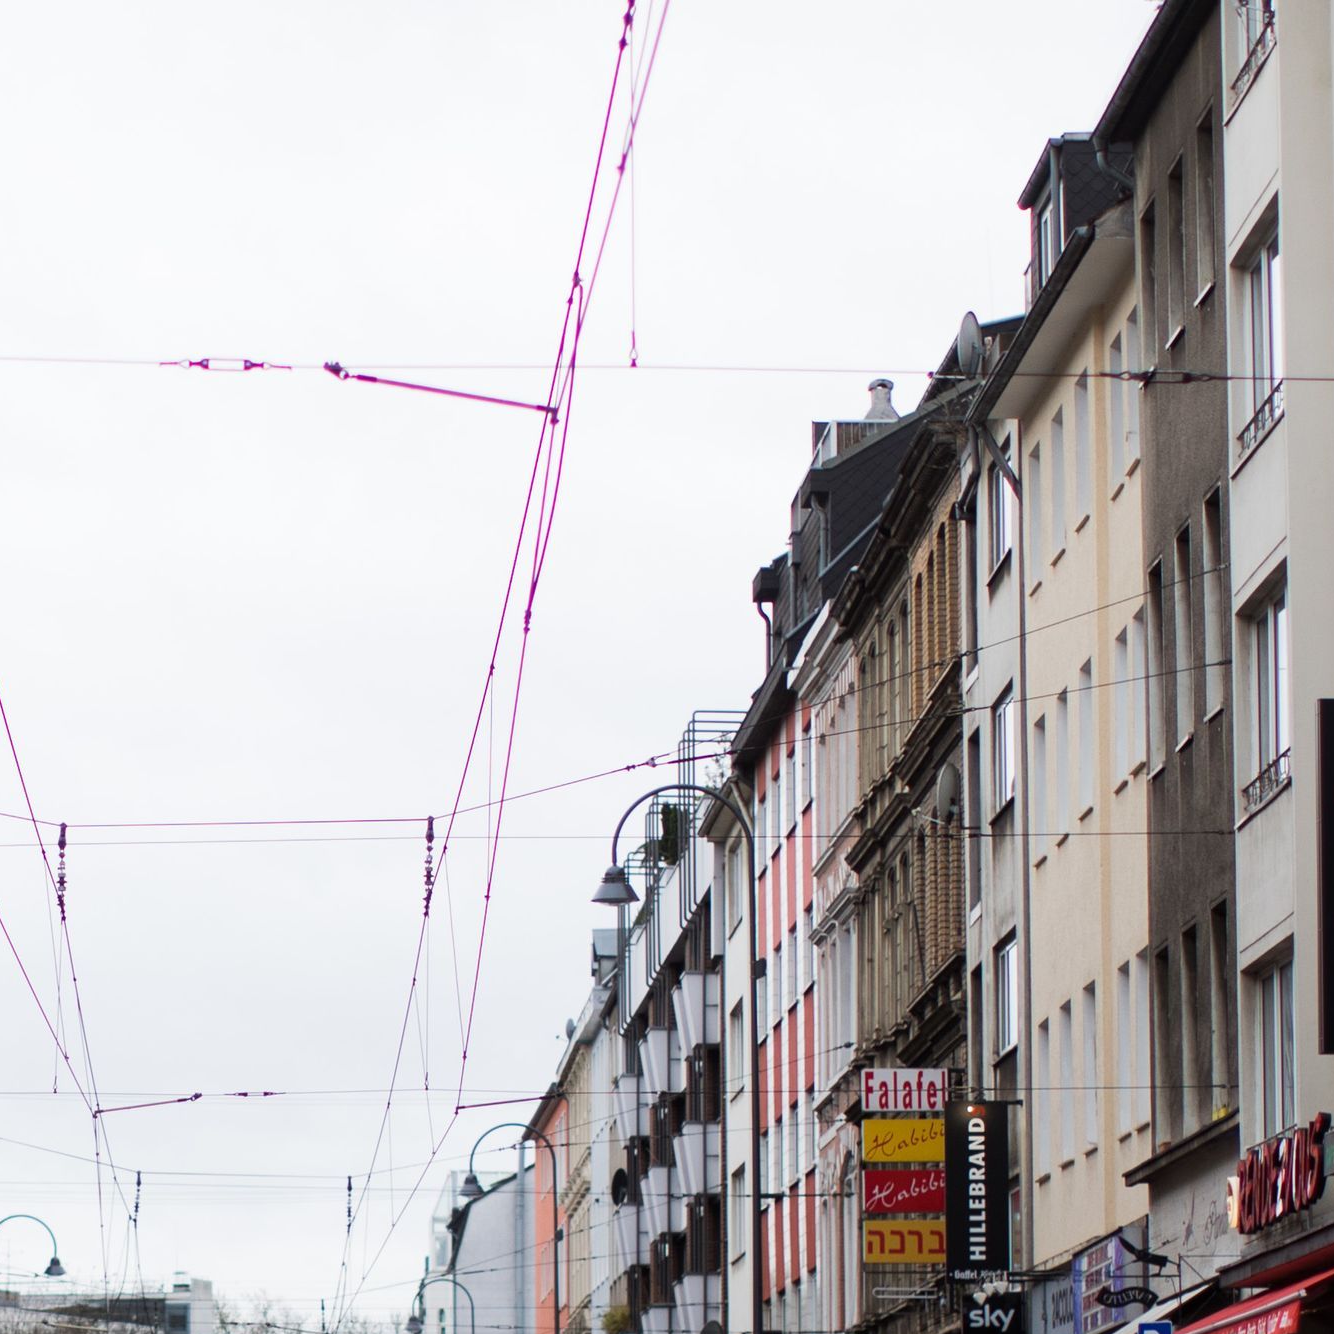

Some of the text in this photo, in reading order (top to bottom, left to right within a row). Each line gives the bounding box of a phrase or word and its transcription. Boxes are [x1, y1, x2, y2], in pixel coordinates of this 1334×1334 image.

[864, 1070, 945, 1110] Falafel
[866, 1121, 945, 1160] Habibi
[866, 1172, 945, 1211] Habibi
[868, 1230, 945, 1254] ברכה
[969, 1304, 1015, 1332] sky
